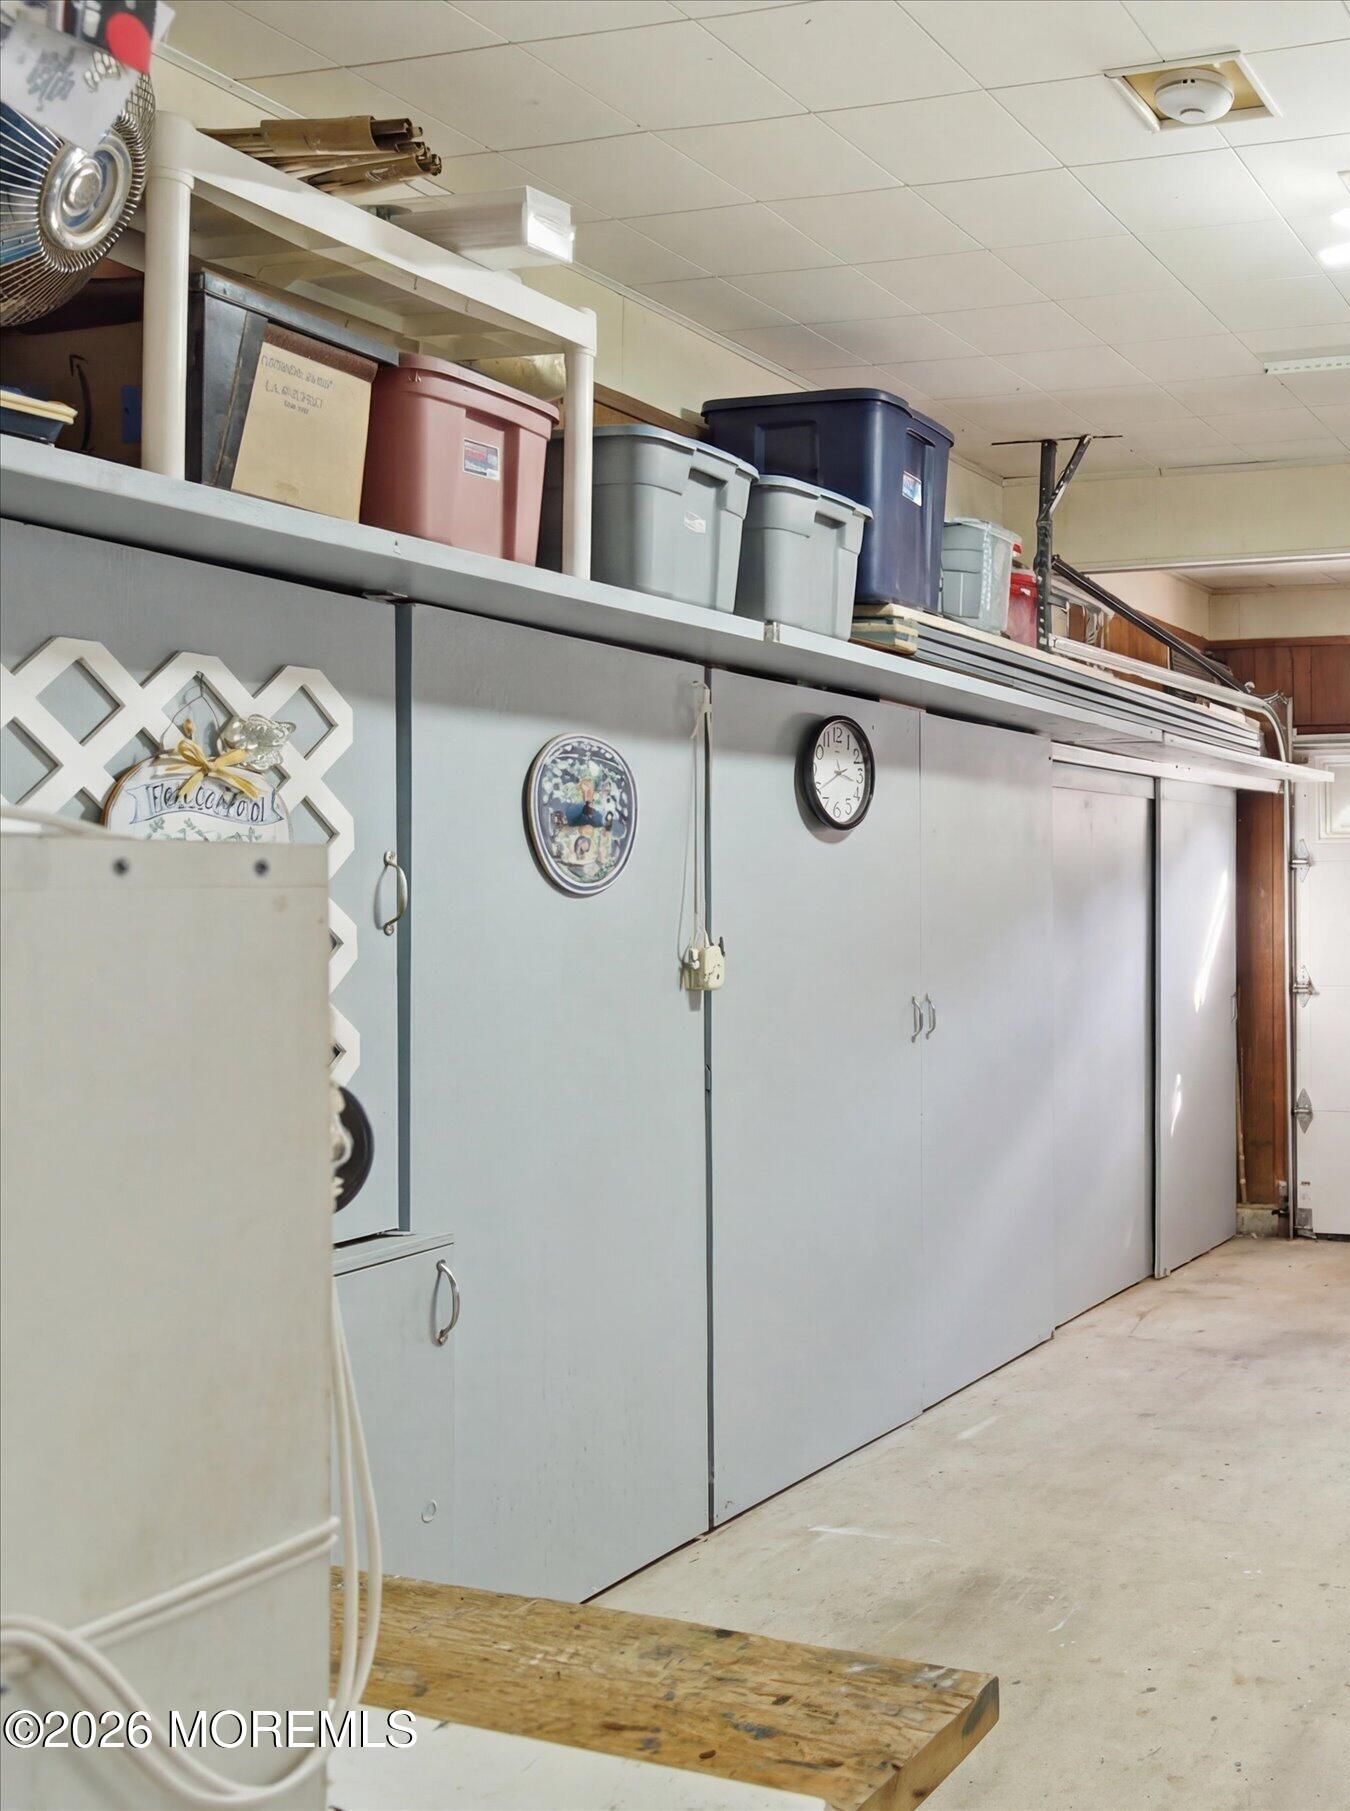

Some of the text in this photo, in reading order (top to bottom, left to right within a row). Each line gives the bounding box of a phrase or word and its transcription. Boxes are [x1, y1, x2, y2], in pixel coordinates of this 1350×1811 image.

[823, 731, 830, 747] 11
[833, 727, 843, 743] 12
[853, 748, 863, 764] 2
[856, 767, 864, 784] 3
[853, 786, 861, 801] 4
[822, 796, 829, 810] 7
[832, 801, 841, 818] 6
[845, 798, 852, 815] 5
